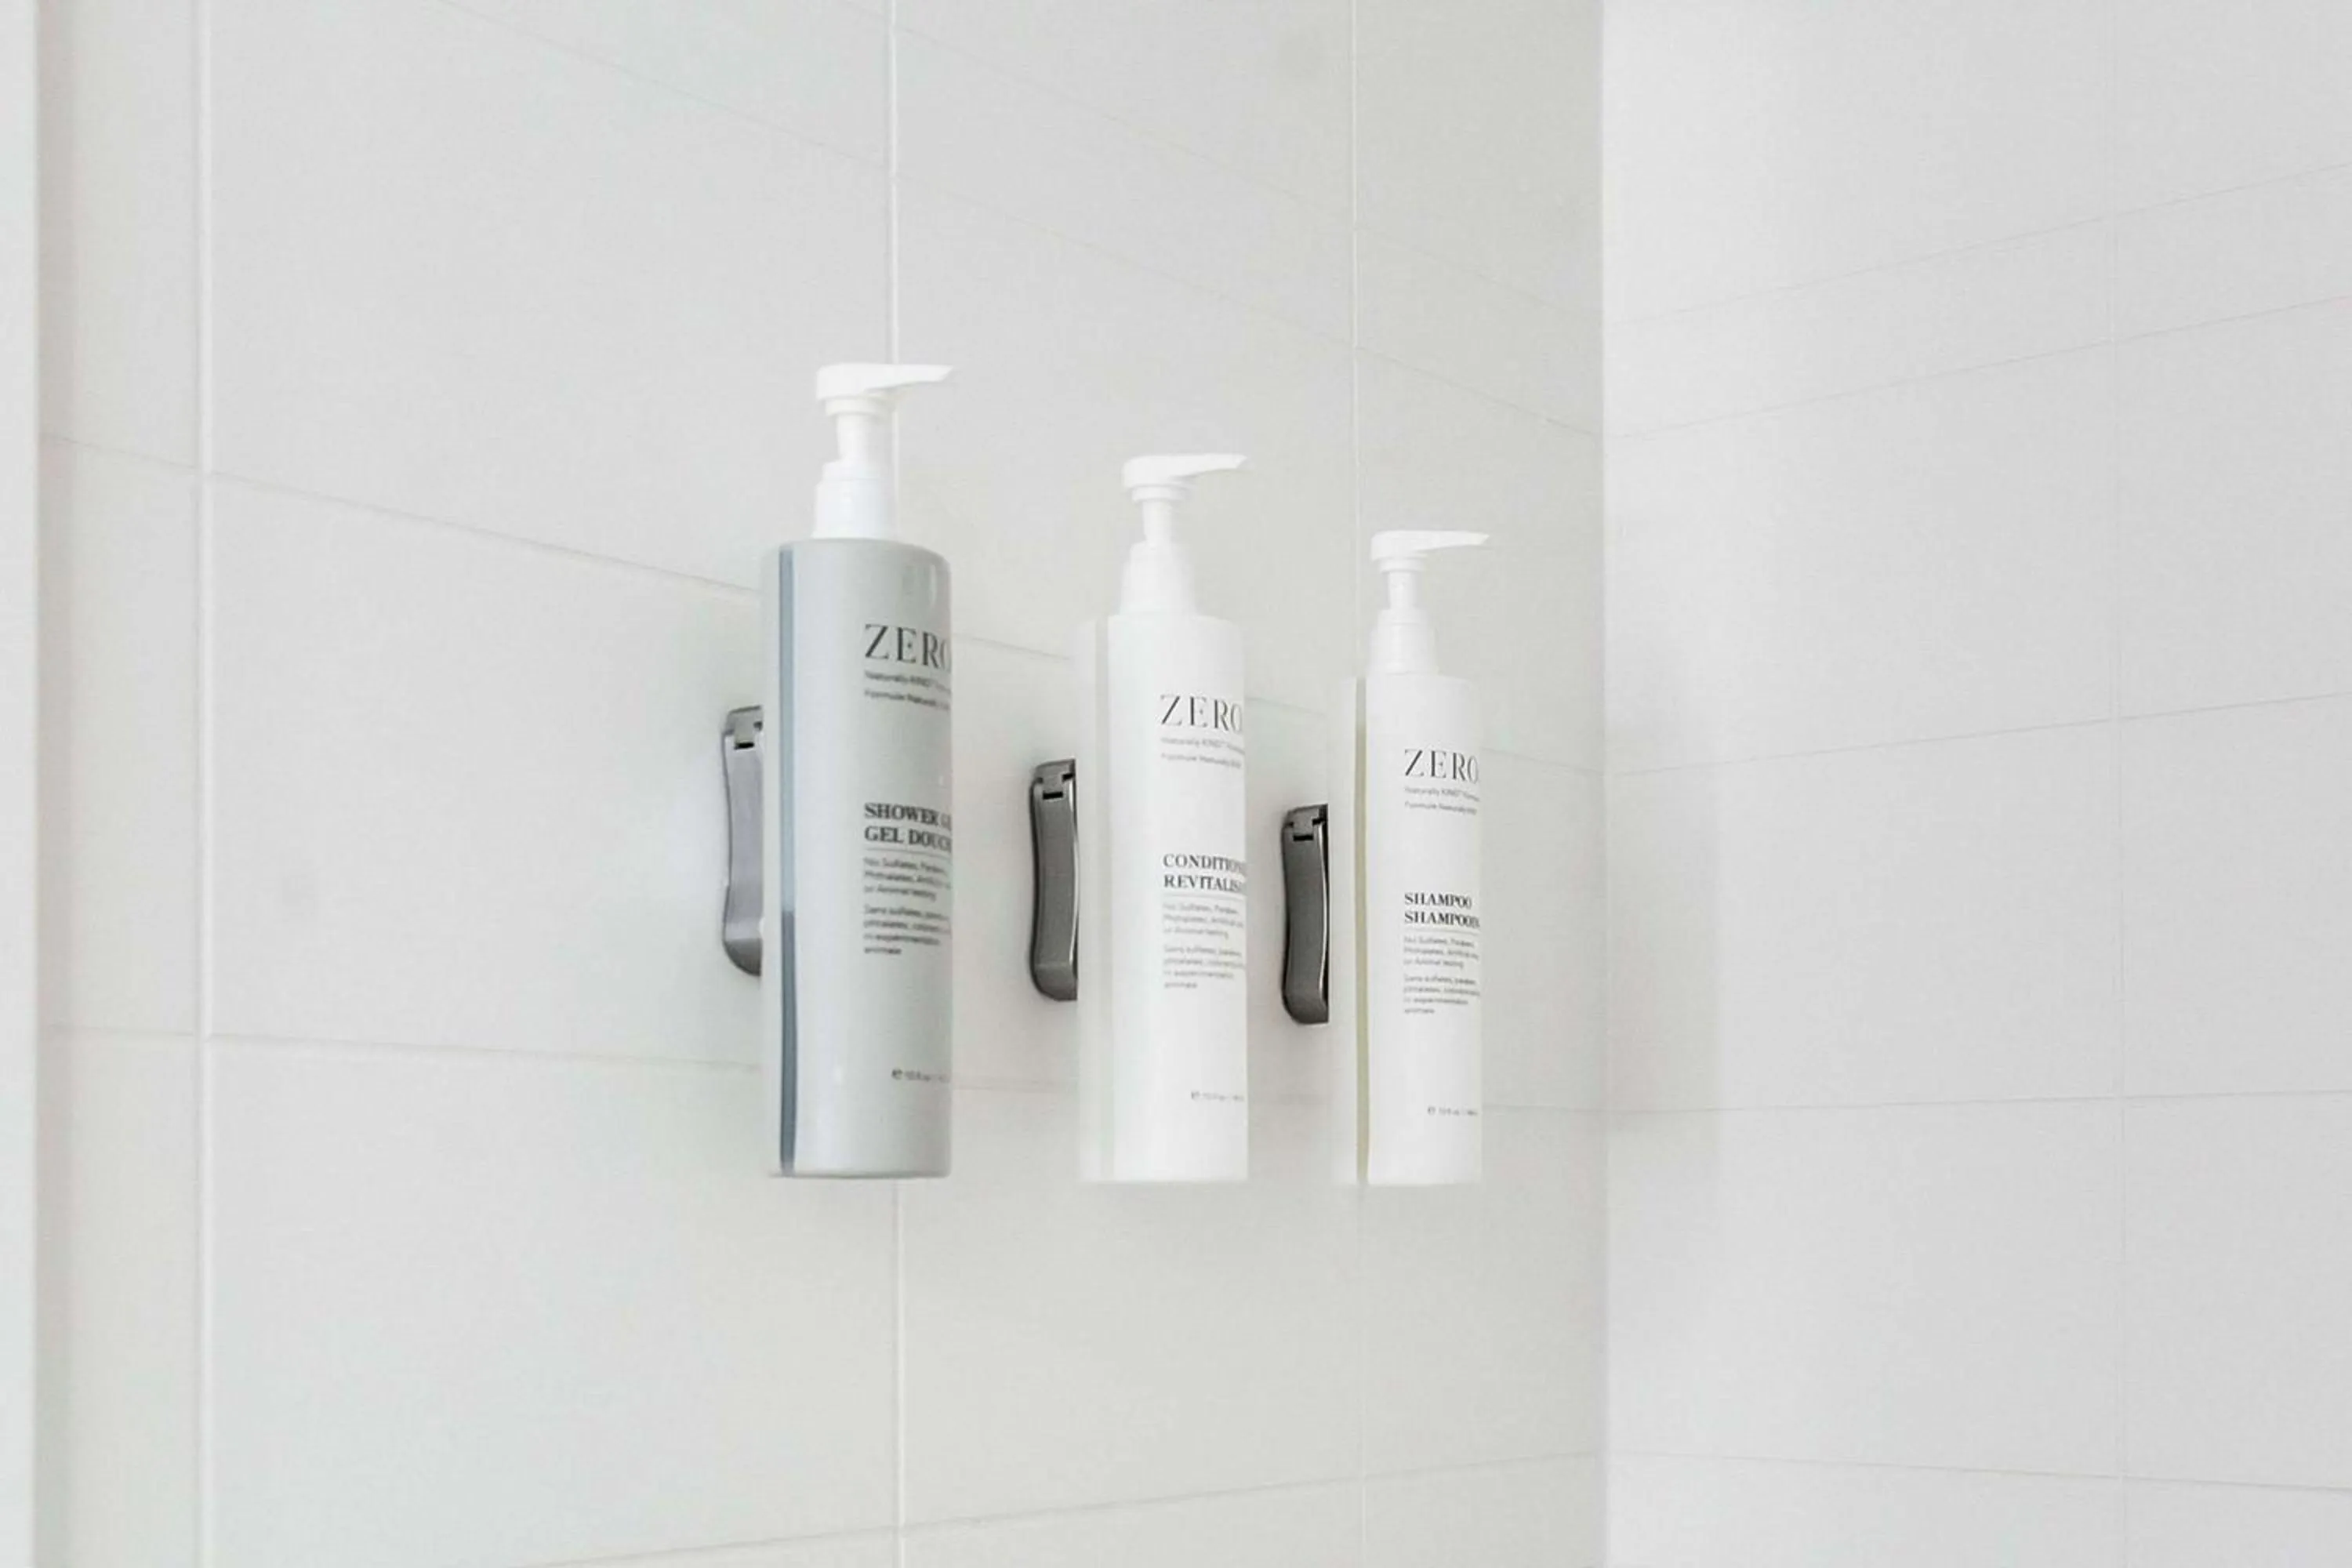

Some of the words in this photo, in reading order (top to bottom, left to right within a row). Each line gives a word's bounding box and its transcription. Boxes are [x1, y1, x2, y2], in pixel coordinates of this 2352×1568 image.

[1161, 695, 1243, 734] ZERO
[1404, 749, 1479, 785] ZERO
[864, 802, 939, 826] SHOWER
[864, 826, 905, 844] GEL
[1404, 892, 1472, 909] SHAMPOO
